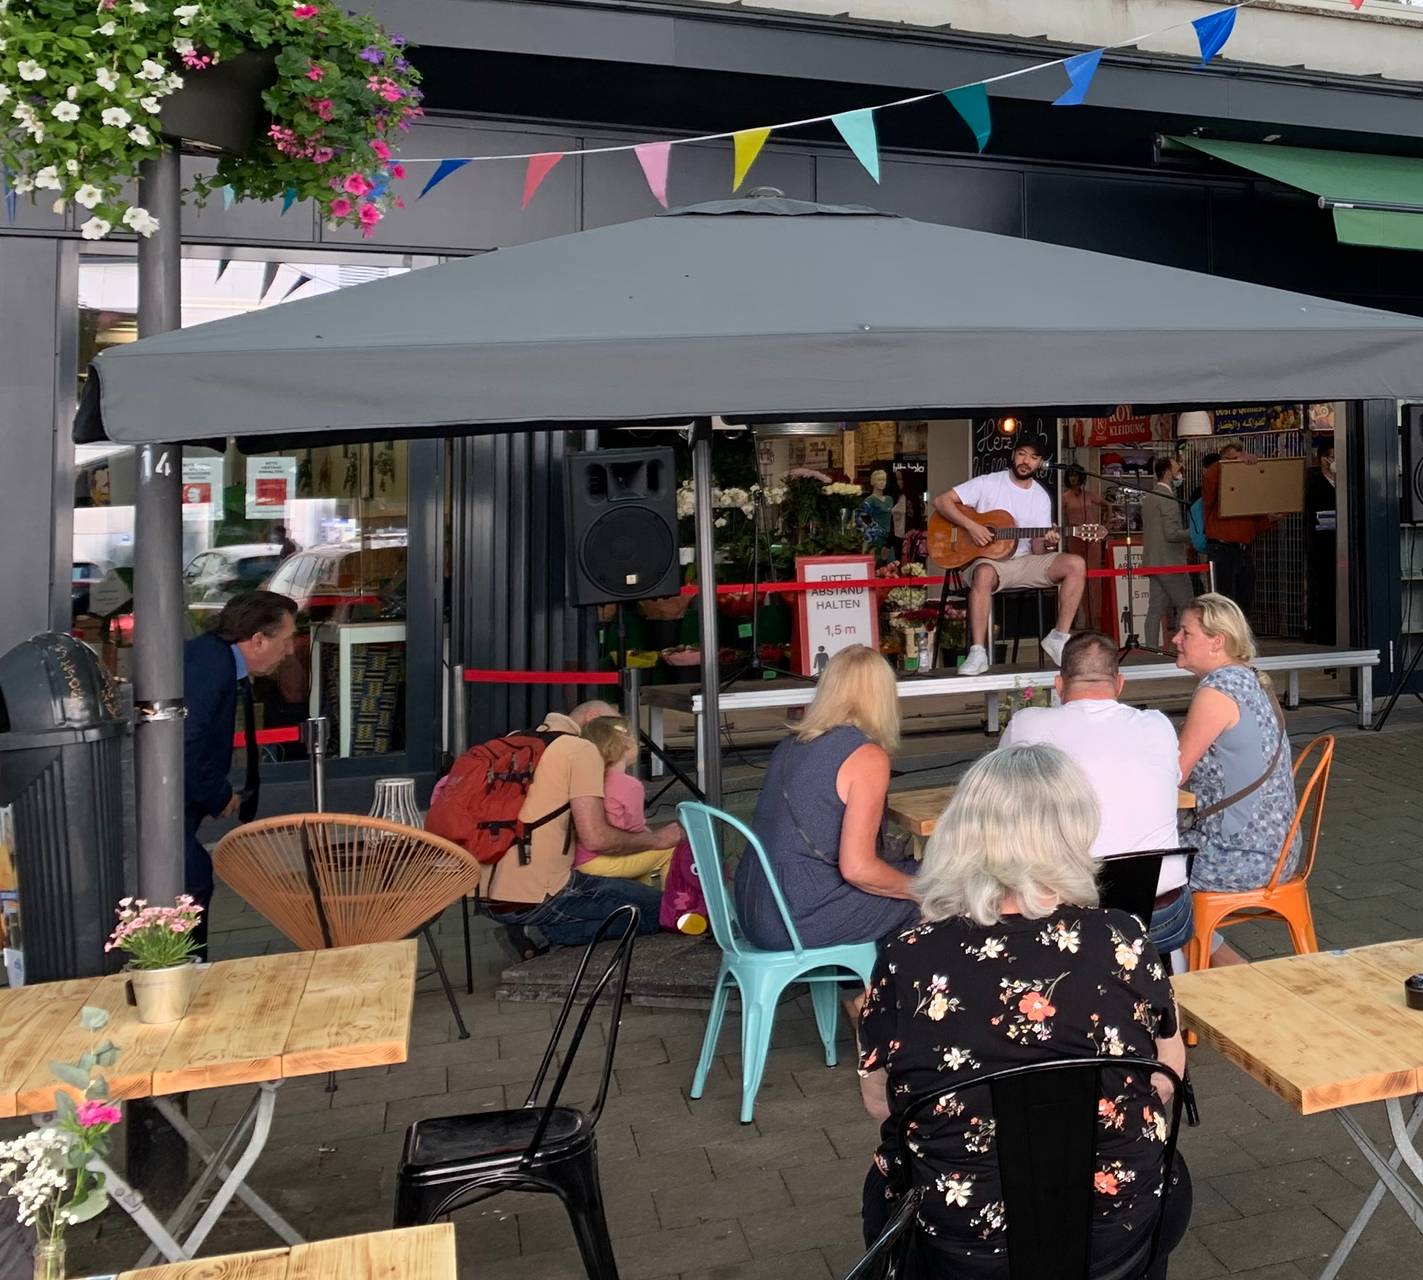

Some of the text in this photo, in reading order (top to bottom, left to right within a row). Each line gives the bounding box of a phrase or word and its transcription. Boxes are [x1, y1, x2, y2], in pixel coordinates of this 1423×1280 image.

[141, 450, 171, 477] 14
[811, 586, 864, 597] ABSTAND
[816, 600, 860, 610] HALTEN
[824, 624, 856, 637] 1,5 m
